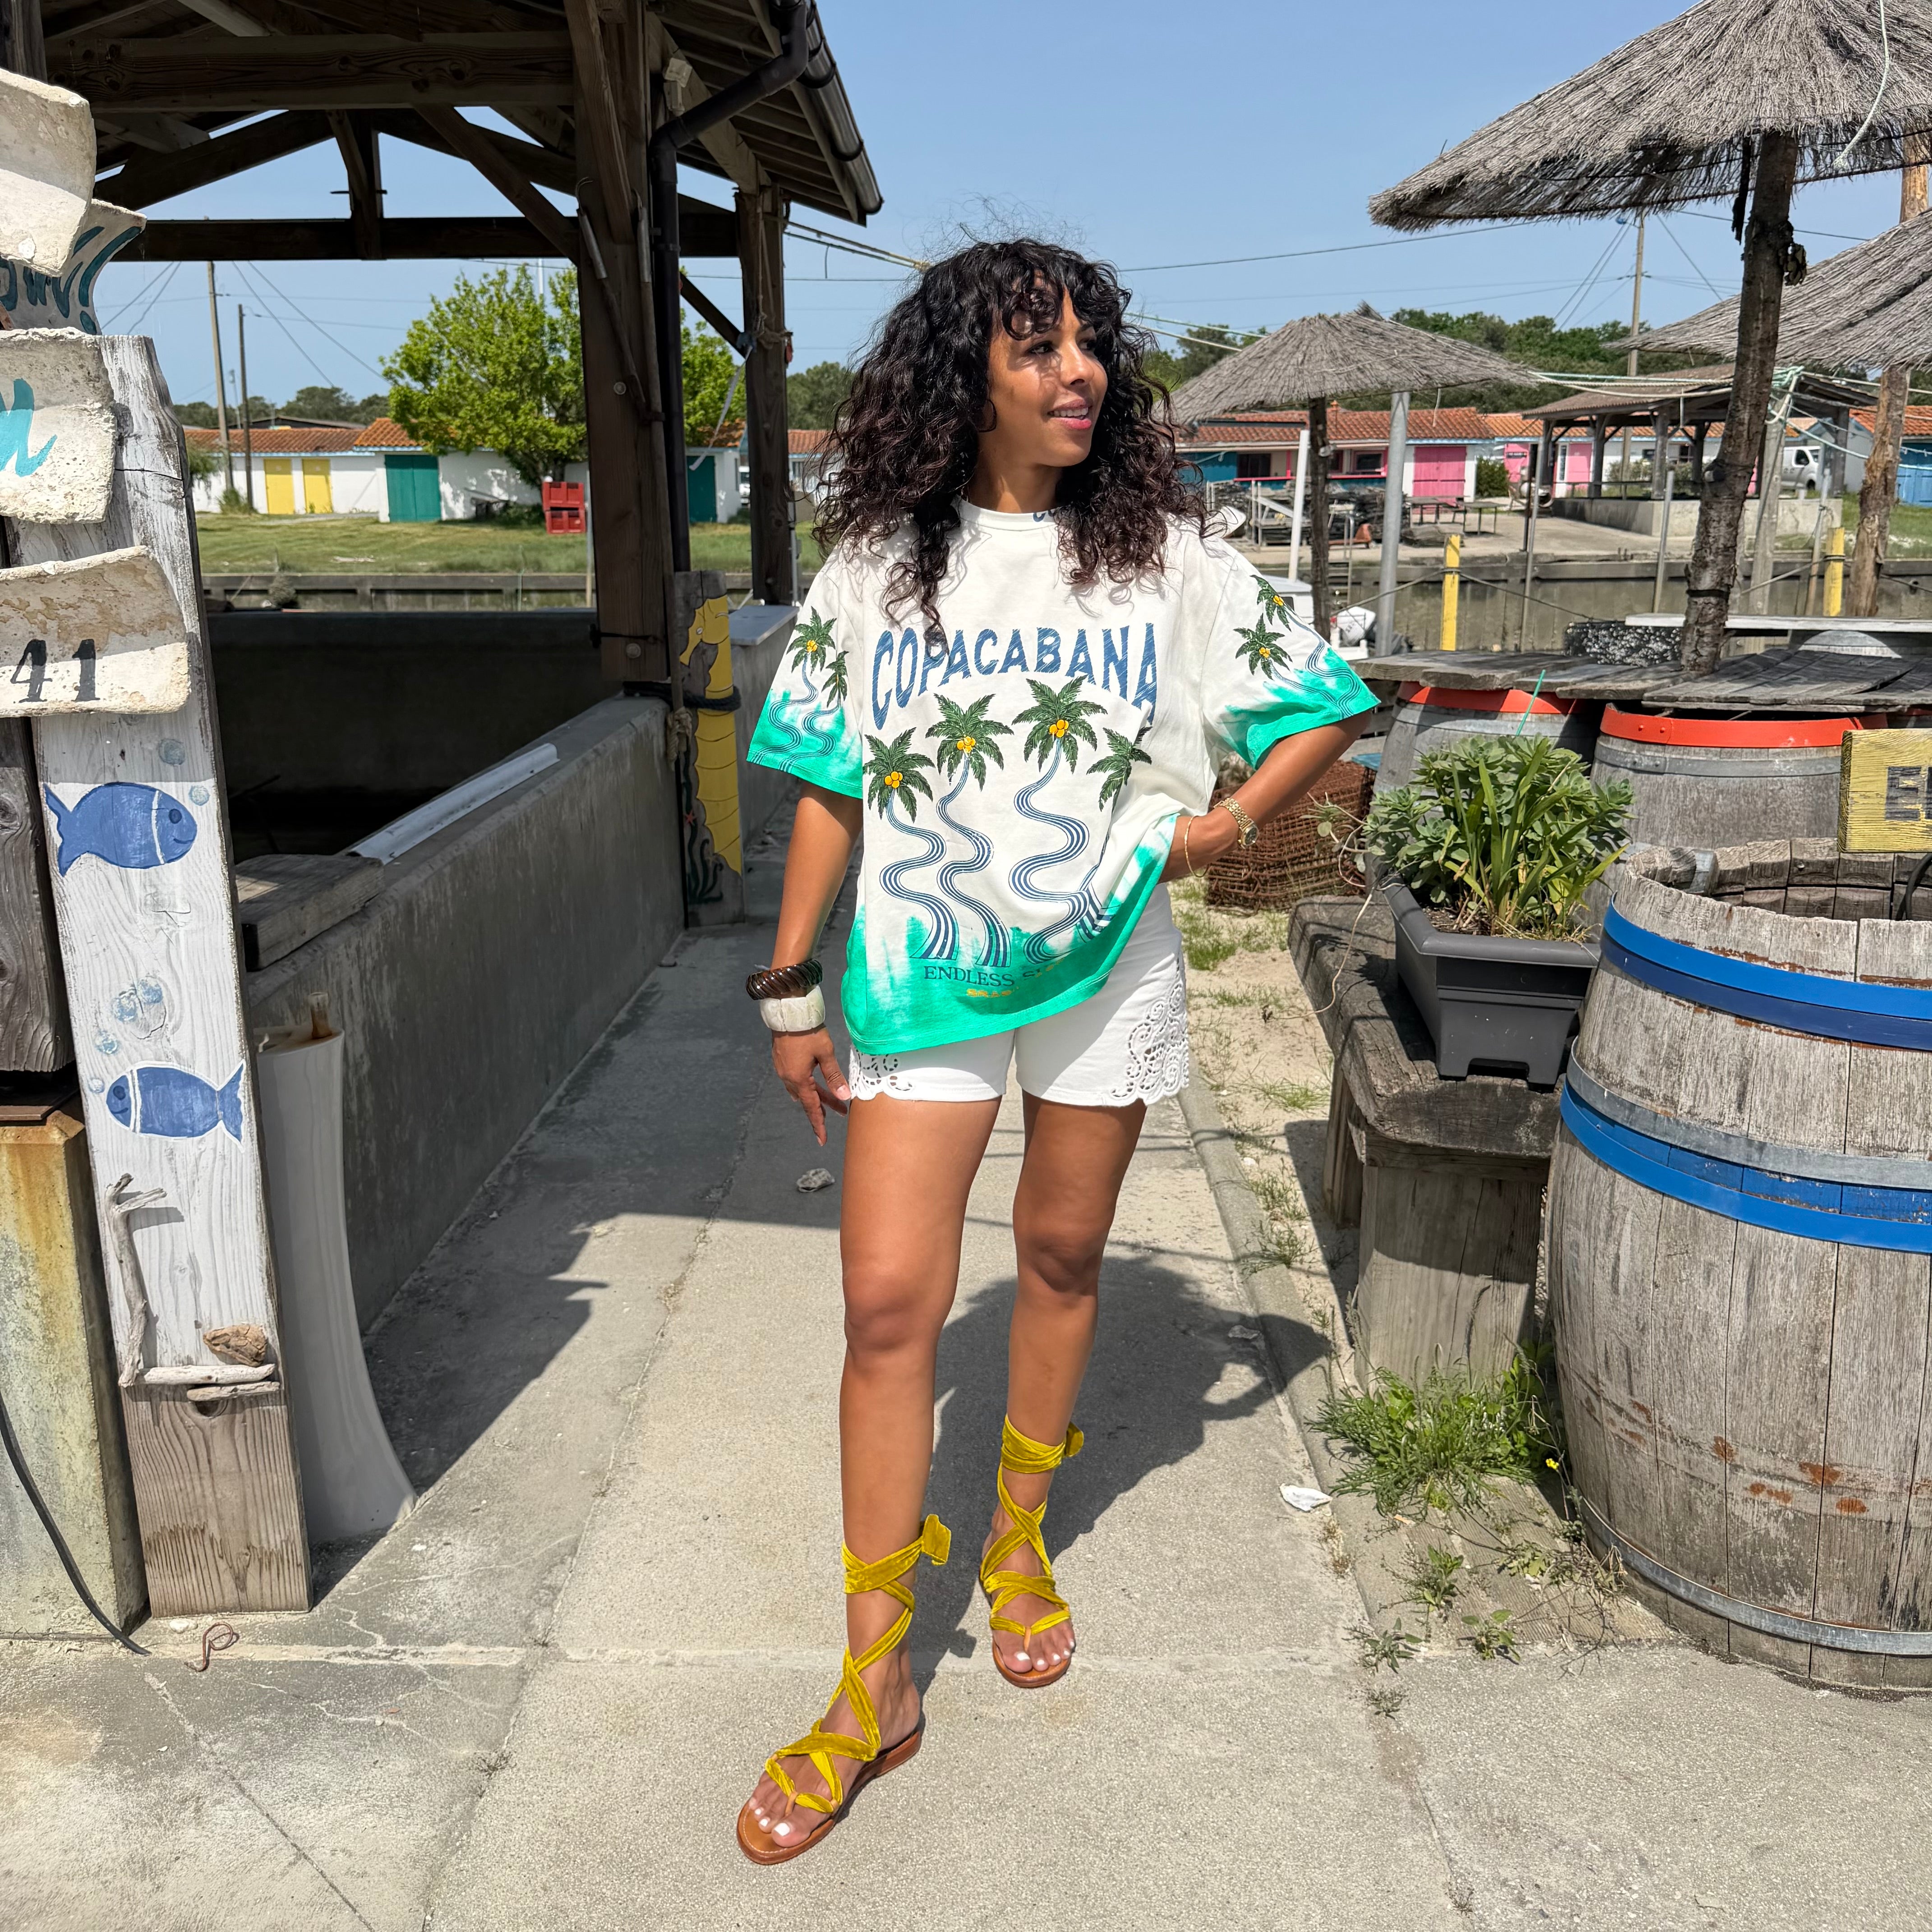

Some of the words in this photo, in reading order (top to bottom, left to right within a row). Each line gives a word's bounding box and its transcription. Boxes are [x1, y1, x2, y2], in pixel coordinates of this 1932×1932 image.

[10, 638, 101, 703] 41
[872, 622, 1157, 730] COPACABANA
[924, 966, 1015, 987] ENDLESS
